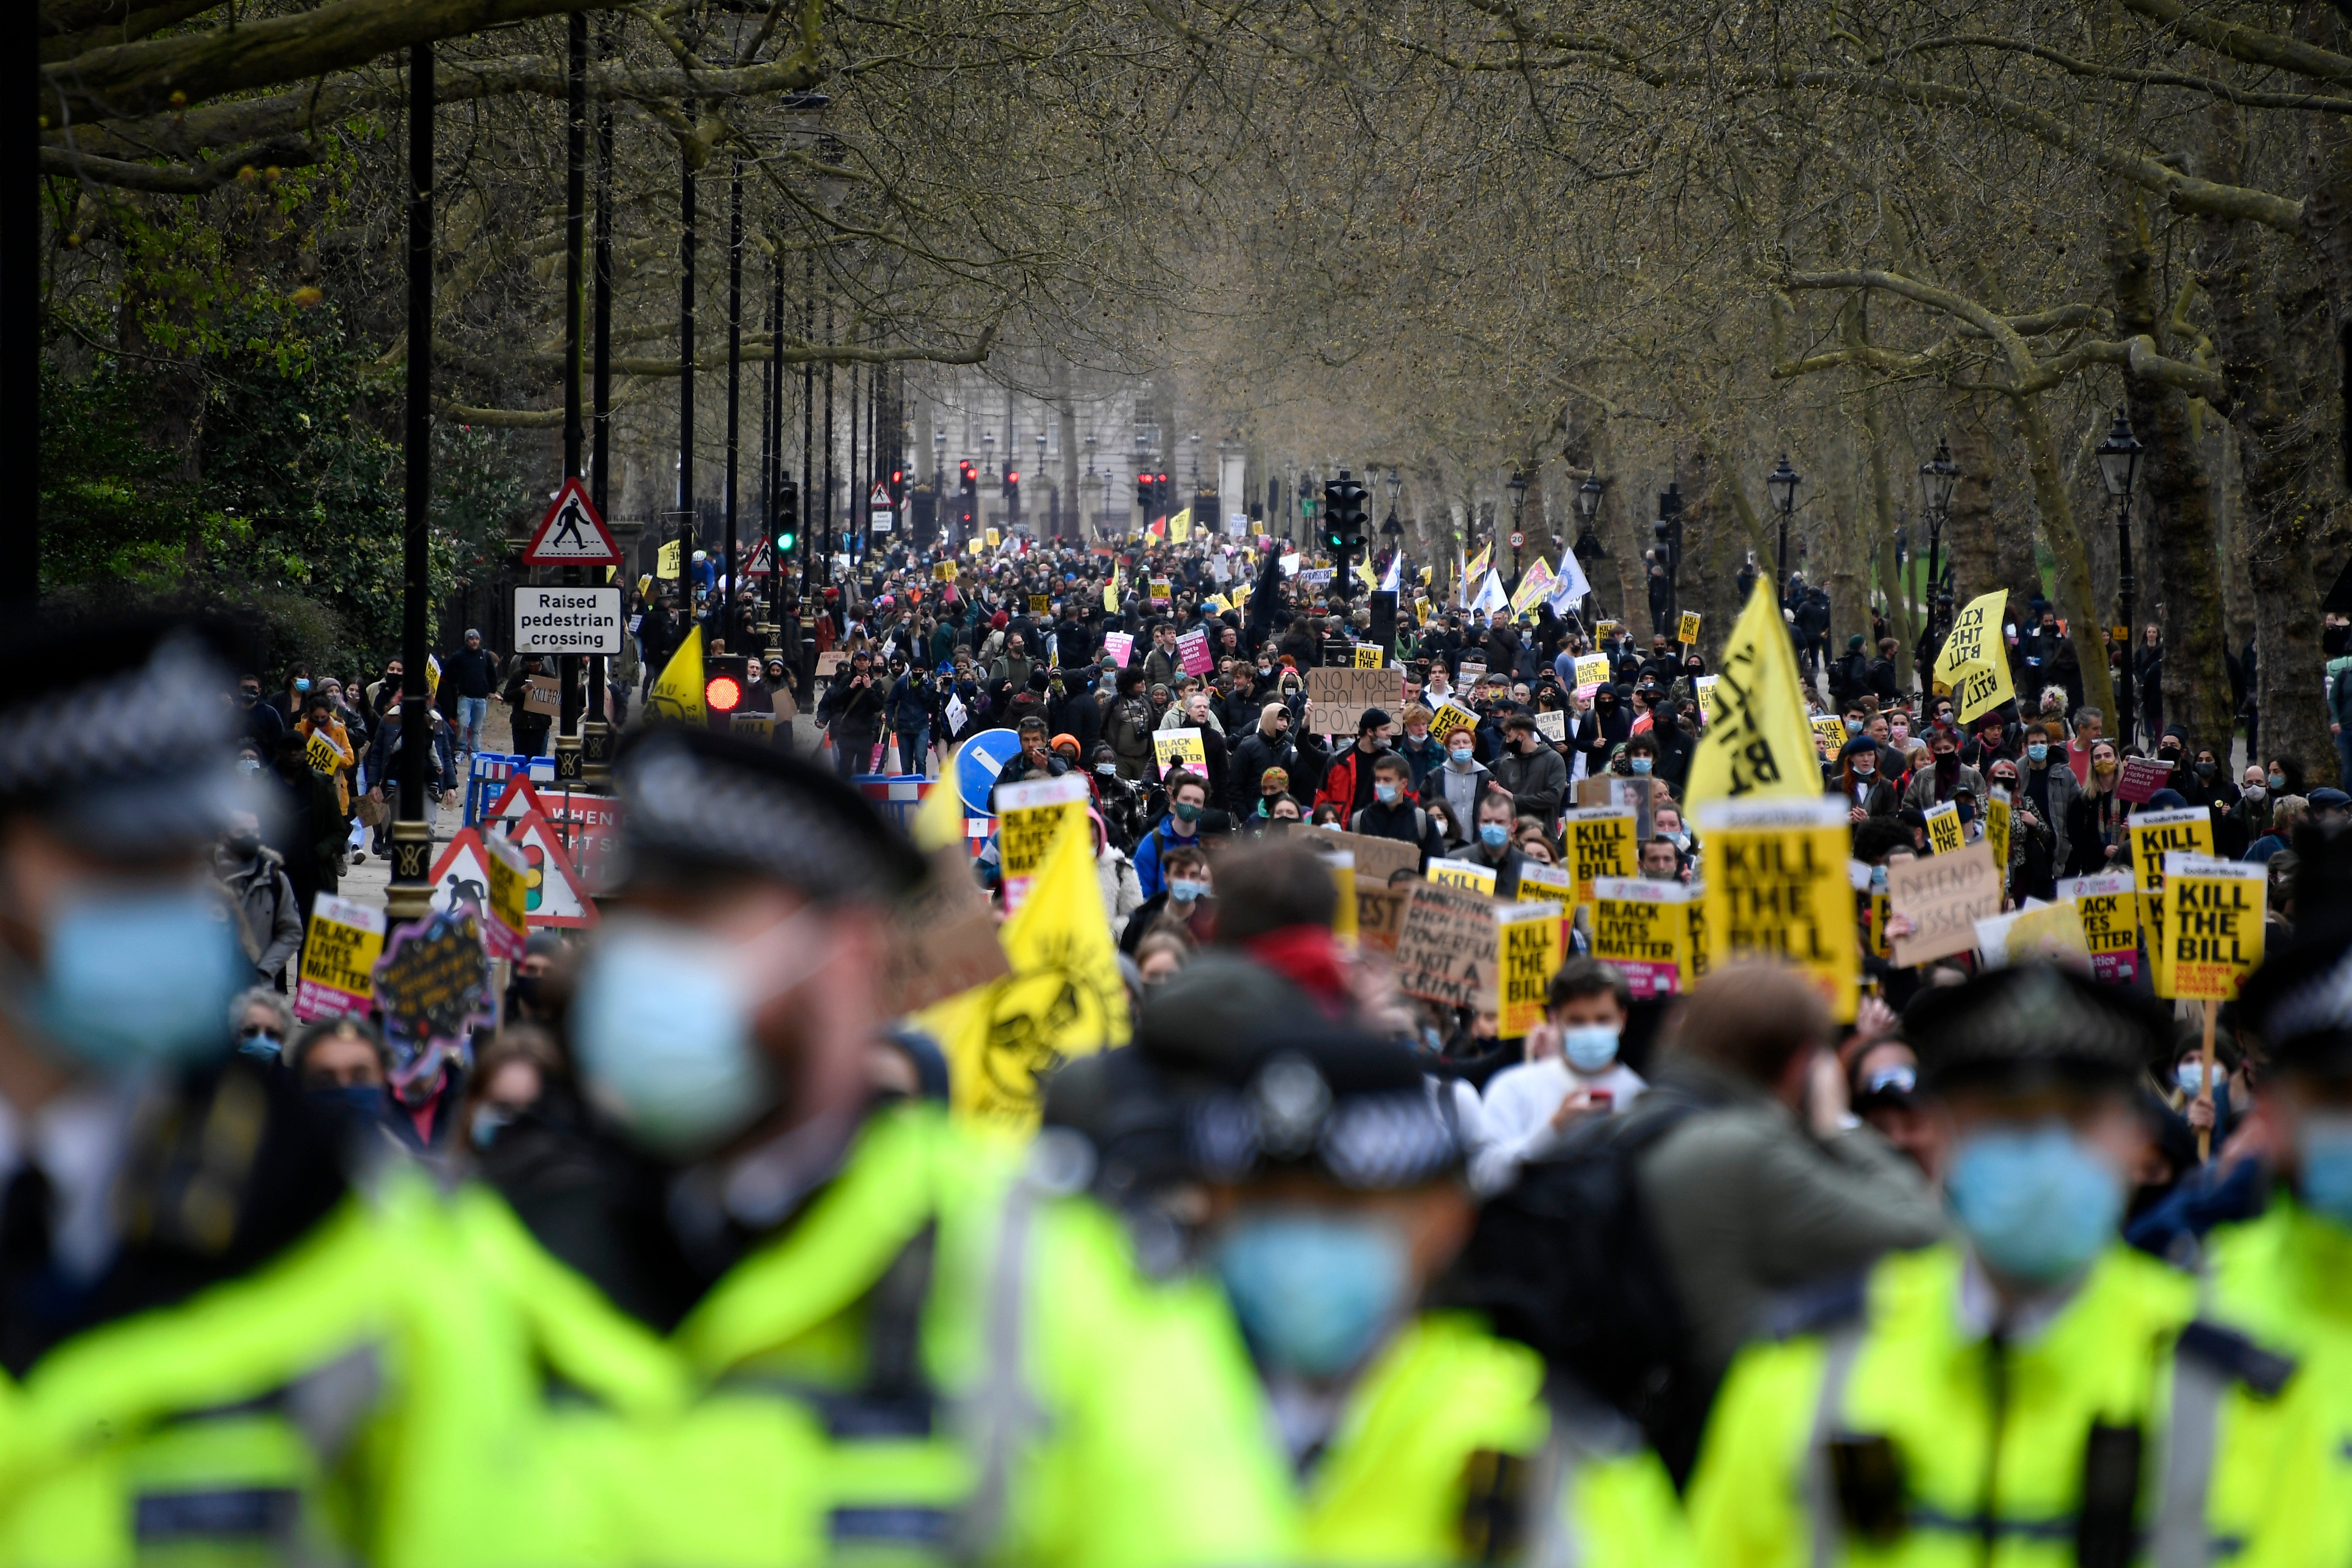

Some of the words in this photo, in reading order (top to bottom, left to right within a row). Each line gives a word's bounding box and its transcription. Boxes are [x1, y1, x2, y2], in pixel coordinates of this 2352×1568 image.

[539, 594, 596, 608] Raised
[521, 613, 614, 629] pedestrian
[1685, 616, 1697, 624] KILL
[531, 632, 603, 648] crossing
[1682, 628, 1695, 636] BILL
[1179, 640, 1196, 650] Defend
[1183, 651, 1200, 662] protest
[1358, 659, 1375, 669] THE
[1359, 650, 1379, 661] KILL
[1578, 661, 1600, 672] BLACK
[1578, 669, 1598, 678] LIVES
[1315, 671, 1342, 690] NO
[1351, 671, 1401, 691] MORE
[1579, 675, 1608, 685] MATTER
[1700, 685, 1716, 693] BLA
[532, 687, 547, 703] KILL
[552, 690, 561, 706] BI
[1323, 689, 1397, 710] POLICE
[1701, 693, 1715, 701] LIV
[1315, 708, 1402, 735] POWS
[1438, 716, 1455, 730] TH
[1537, 715, 1551, 724] HER
[1552, 713, 1563, 721] BE
[1817, 722, 1840, 732] KILL
[735, 722, 767, 735] KILL
[1433, 726, 1446, 741] BI
[1825, 731, 1840, 740] HE
[1157, 738, 1191, 748] BLACK
[1159, 746, 1188, 756] LIVES
[311, 740, 333, 768] KILL
[1160, 754, 1203, 764] MTER
[2126, 771, 2146, 779] right
[2129, 764, 2155, 774] Defend
[2123, 777, 2151, 787] protest
[552, 808, 612, 825] WHEN
[1576, 822, 1627, 842] KILL
[1932, 816, 1957, 837] KILL
[1936, 832, 1958, 853] THE
[2142, 827, 2202, 852] KILL
[1576, 843, 1620, 861] THE
[1725, 836, 1832, 882] KILL
[1578, 861, 1628, 880] BILL
[1437, 873, 1484, 896] KILL
[1900, 859, 1985, 905] DEFEND
[1522, 882, 1570, 903] Refugees
[1727, 884, 1818, 919] THE
[2178, 883, 2251, 910] KILL
[1599, 901, 1658, 920] BLACK
[2084, 896, 2117, 914] ACK
[1598, 920, 1649, 940] LIVES
[2177, 910, 2239, 936] THE
[315, 917, 365, 948] BLACK
[1509, 926, 1552, 950] KILL
[2090, 930, 2133, 950] TTER
[310, 939, 352, 966] LIVES
[1598, 939, 1674, 958] MATTER
[2177, 937, 2251, 966] BILL
[1416, 950, 1453, 974] NOT
[1464, 962, 1481, 988] A
[1508, 952, 1545, 975] THE
[307, 959, 370, 991] MATTER
[1400, 971, 1476, 1006] CRIME
